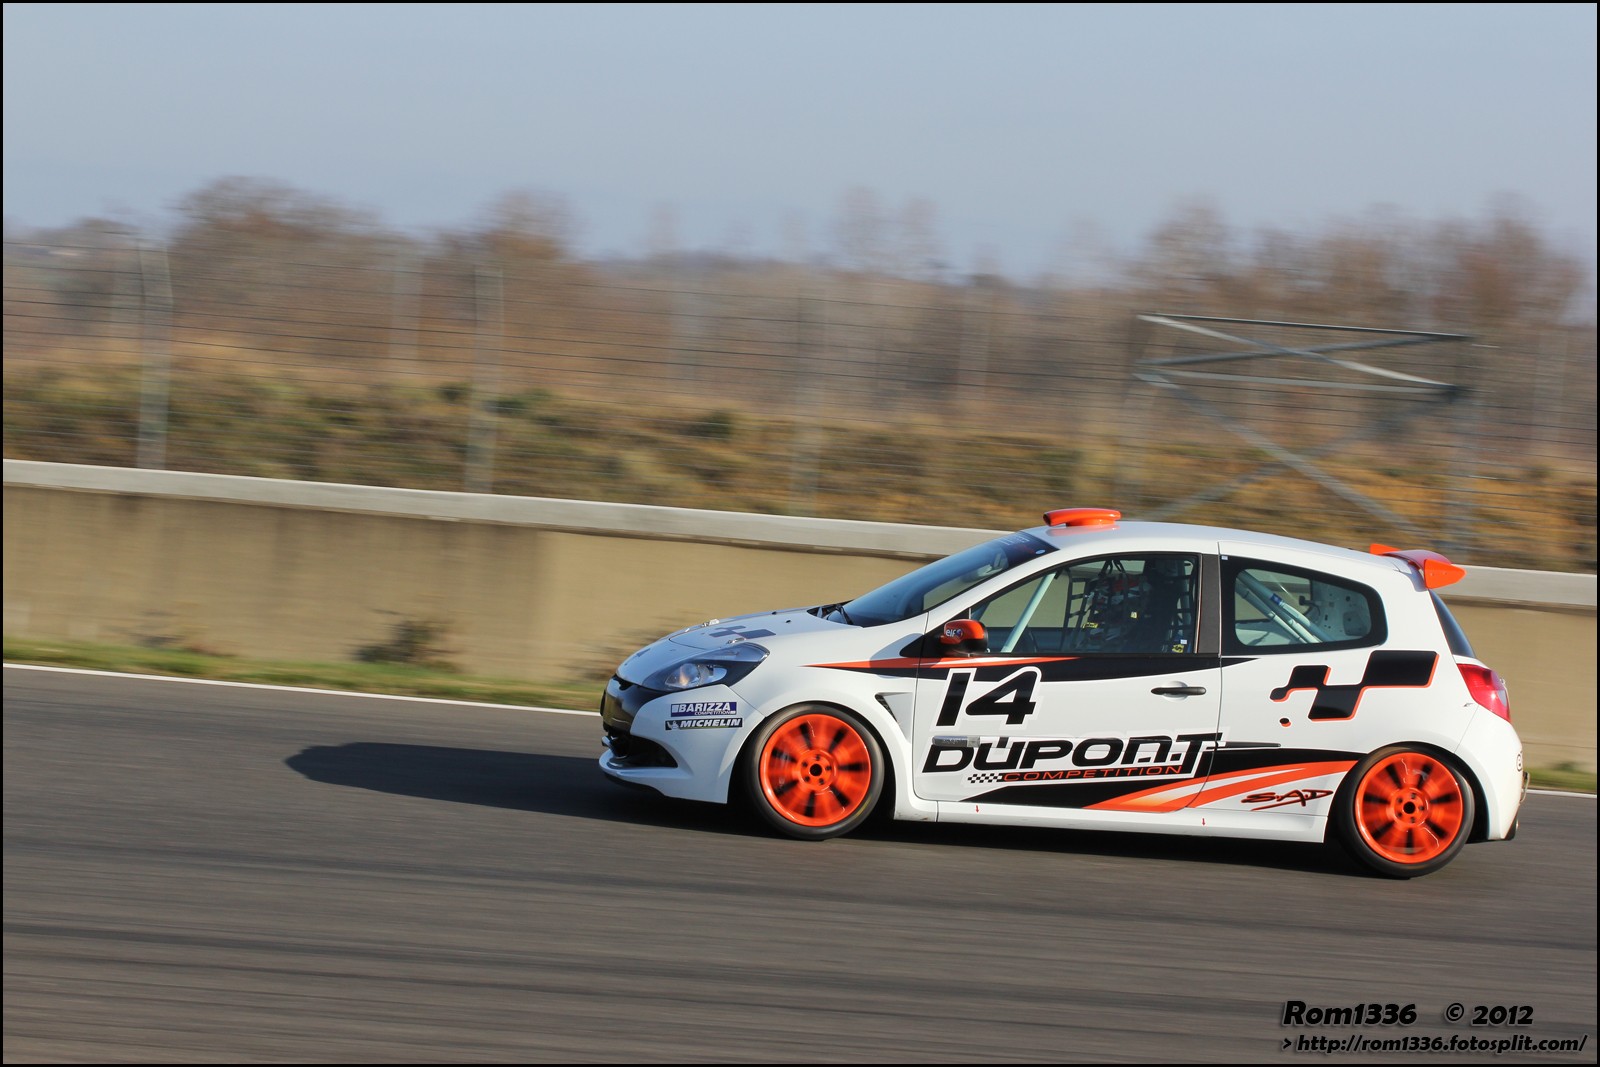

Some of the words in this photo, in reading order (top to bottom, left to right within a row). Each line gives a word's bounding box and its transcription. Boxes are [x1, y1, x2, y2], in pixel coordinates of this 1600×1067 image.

[945, 629, 957, 637] elf
[936, 671, 1037, 726] 14
[679, 702, 731, 713] BARIZZA
[680, 719, 741, 728] MICHELIN
[1003, 765, 1182, 782] COMPETITION
